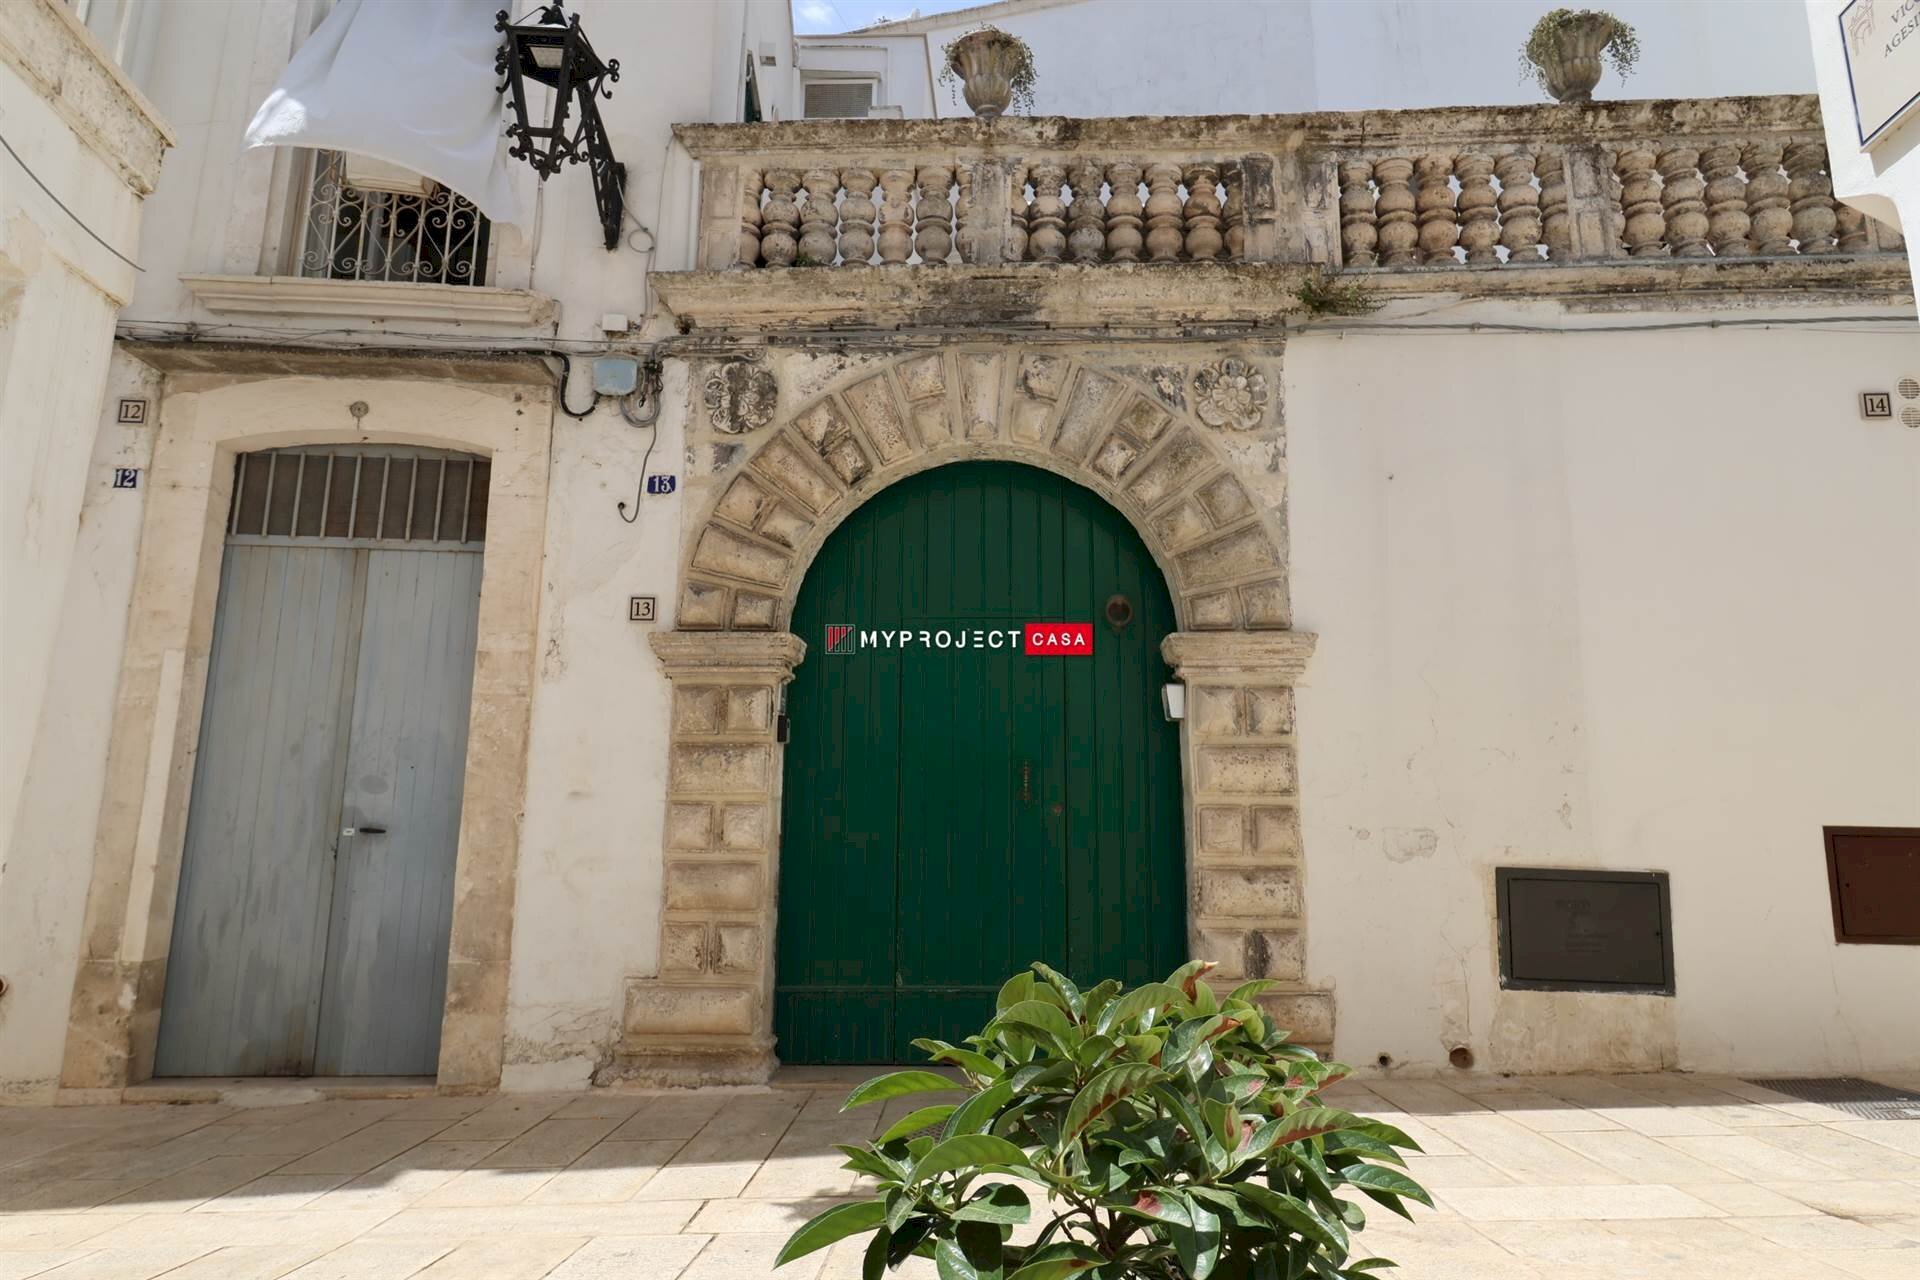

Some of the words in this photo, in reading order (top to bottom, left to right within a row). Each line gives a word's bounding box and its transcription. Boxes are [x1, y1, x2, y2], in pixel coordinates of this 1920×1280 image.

[122, 404, 141, 419] 12
[1868, 397, 1887, 412] 14
[114, 469, 135, 487] 12
[653, 475, 673, 493] 13
[634, 601, 651, 616] 13
